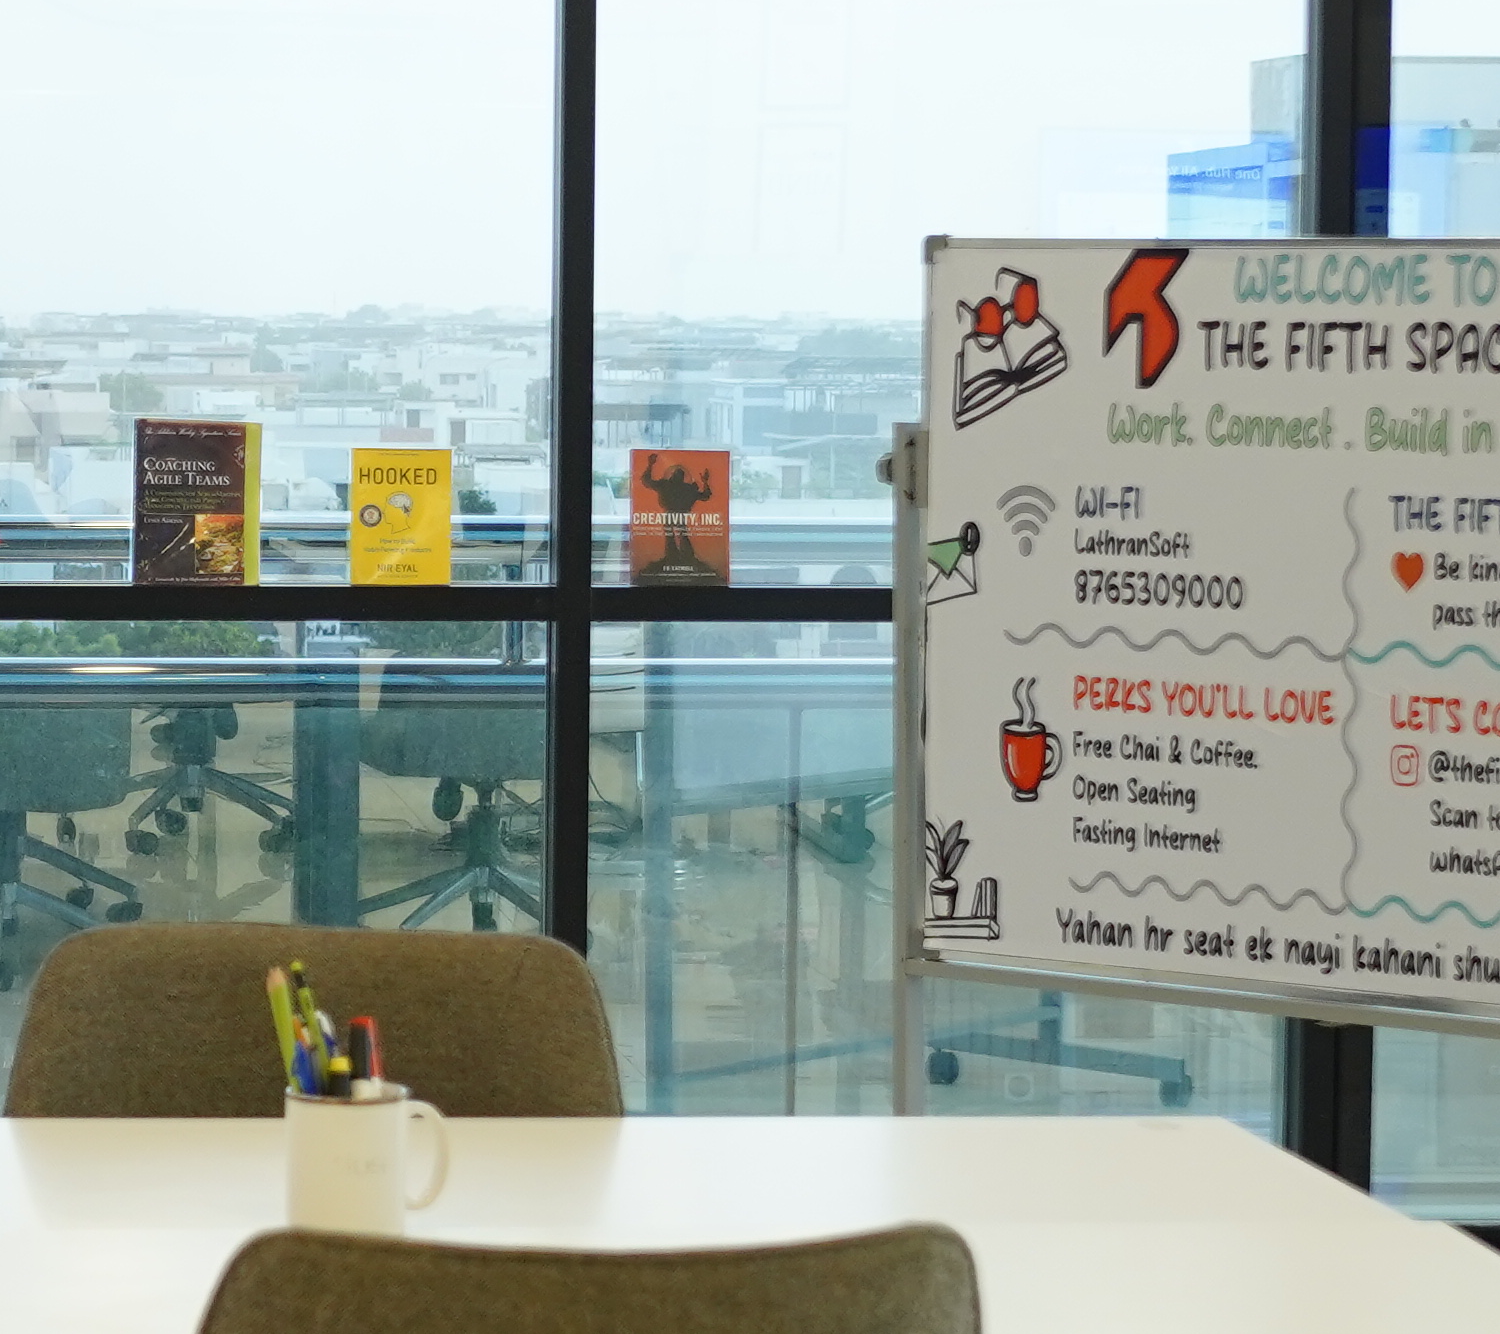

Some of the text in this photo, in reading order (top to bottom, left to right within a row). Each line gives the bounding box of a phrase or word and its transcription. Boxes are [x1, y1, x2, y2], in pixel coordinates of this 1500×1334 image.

[1233, 253, 1500, 306] WELCOME TO
[1197, 321, 1269, 372] THE
[1285, 321, 1393, 374] FIFTH
[1364, 407, 1449, 456] Build
[1462, 409, 1492, 455] in
[143, 457, 216, 471] COACHING
[143, 471, 230, 486] AGILE TEAMS
[359, 467, 437, 485] HOOKED
[633, 512, 723, 526] CREATIVITY, INC.
[1075, 486, 1141, 520] WI-FI
[1388, 494, 1443, 533] THE
[1074, 528, 1191, 559] LathranSoft
[395, 564, 418, 573] EYAL
[1433, 552, 1460, 581] Be
[1074, 569, 1245, 610] 8765309000
[1432, 604, 1475, 630] pass
[1072, 674, 1336, 726] PERKS YOU'LL LOVE
[1390, 694, 1462, 734] LETS
[1072, 730, 1113, 759] Free
[1119, 734, 1160, 762] Chai
[1167, 735, 1183, 765] &
[1072, 774, 1197, 814] Open Seating
[1429, 799, 1478, 829] Scan
[1072, 816, 1221, 854] Fasting Internet
[1055, 906, 1135, 947] Yahan
[1143, 913, 1174, 952] hr
[1183, 921, 1236, 959] seat
[1244, 925, 1274, 962] ek
[1283, 931, 1343, 975] nayi
[1352, 934, 1442, 980] kahani
